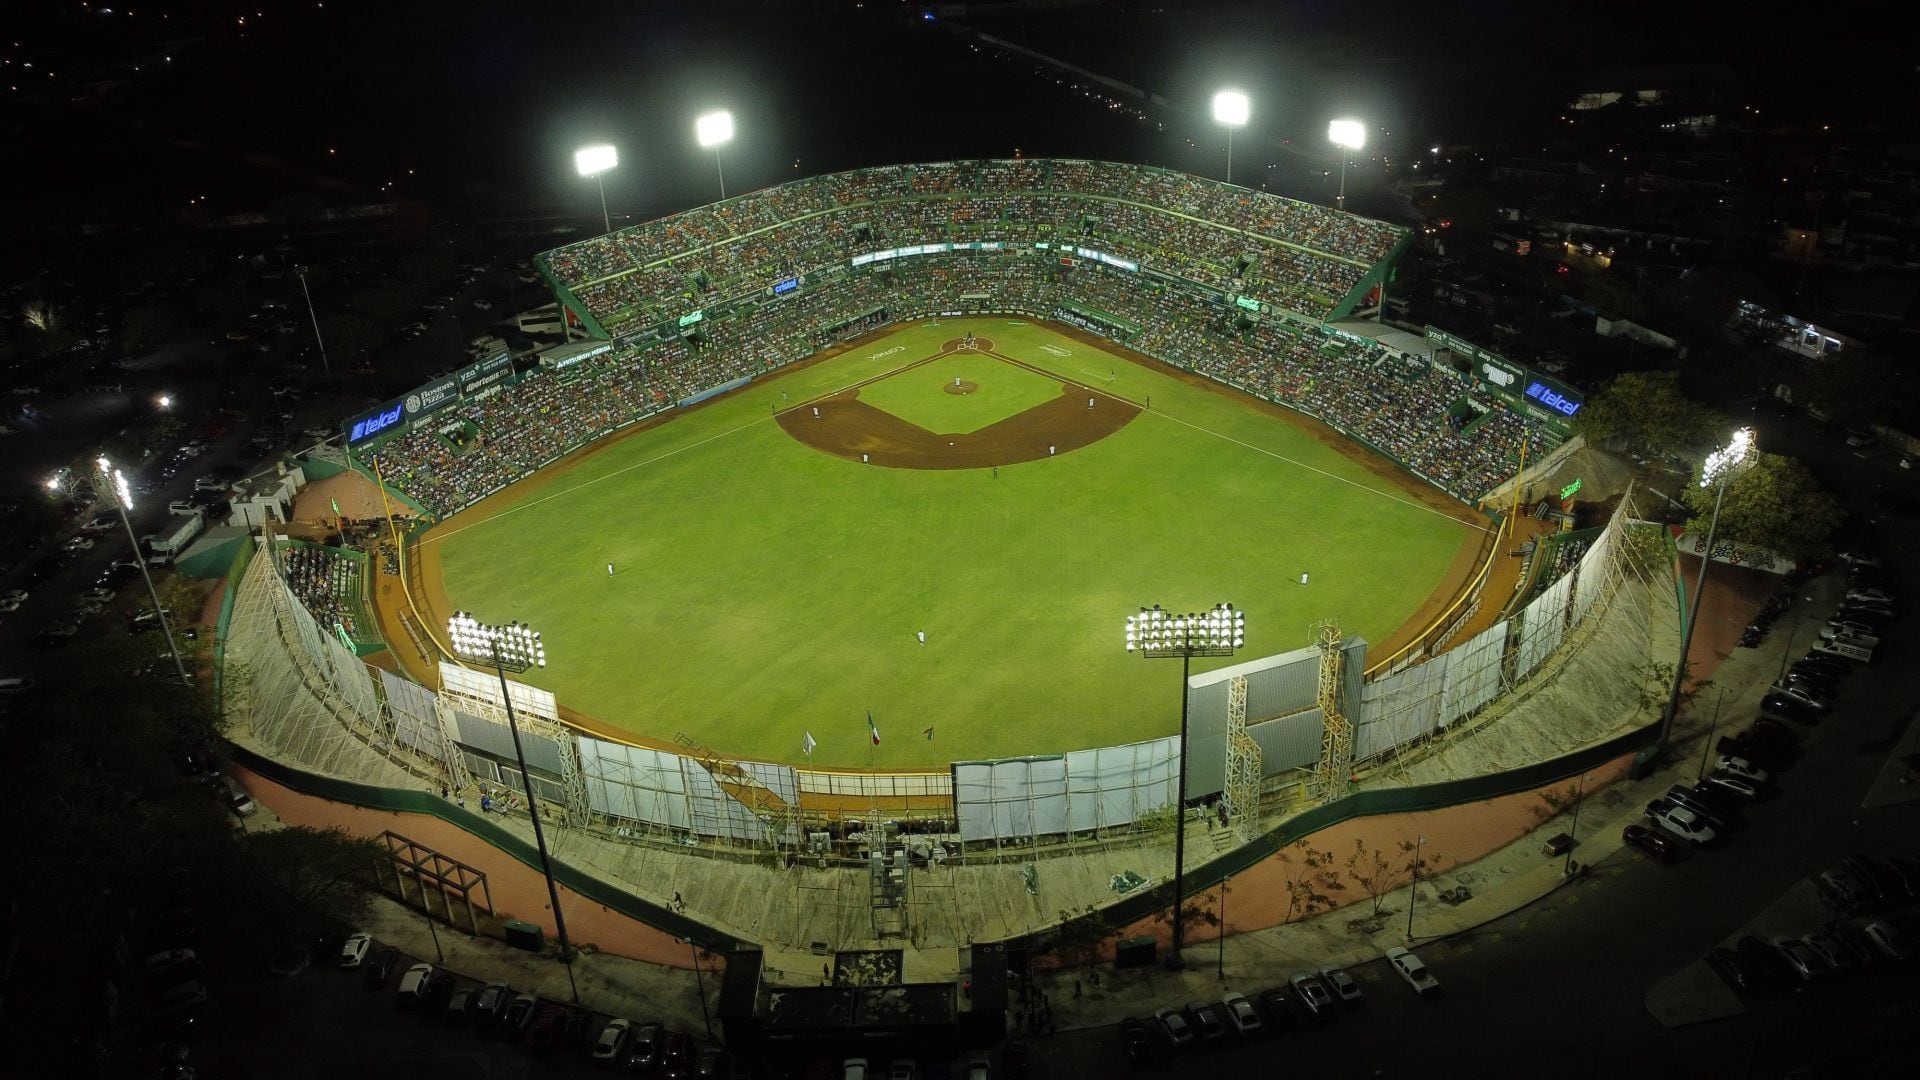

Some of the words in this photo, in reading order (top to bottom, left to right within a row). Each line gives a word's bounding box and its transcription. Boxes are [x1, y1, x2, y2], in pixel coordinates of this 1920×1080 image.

[775, 278, 797, 293] cristal
[1428, 330, 1442, 340] yza
[1478, 351, 1491, 362] Jeep
[459, 370, 476, 382] yza
[466, 371, 500, 393] dportenis
[420, 380, 455, 400] Boston's
[422, 392, 445, 407] Pizza
[1540, 388, 1580, 417] telcel
[364, 403, 403, 436] telcel
